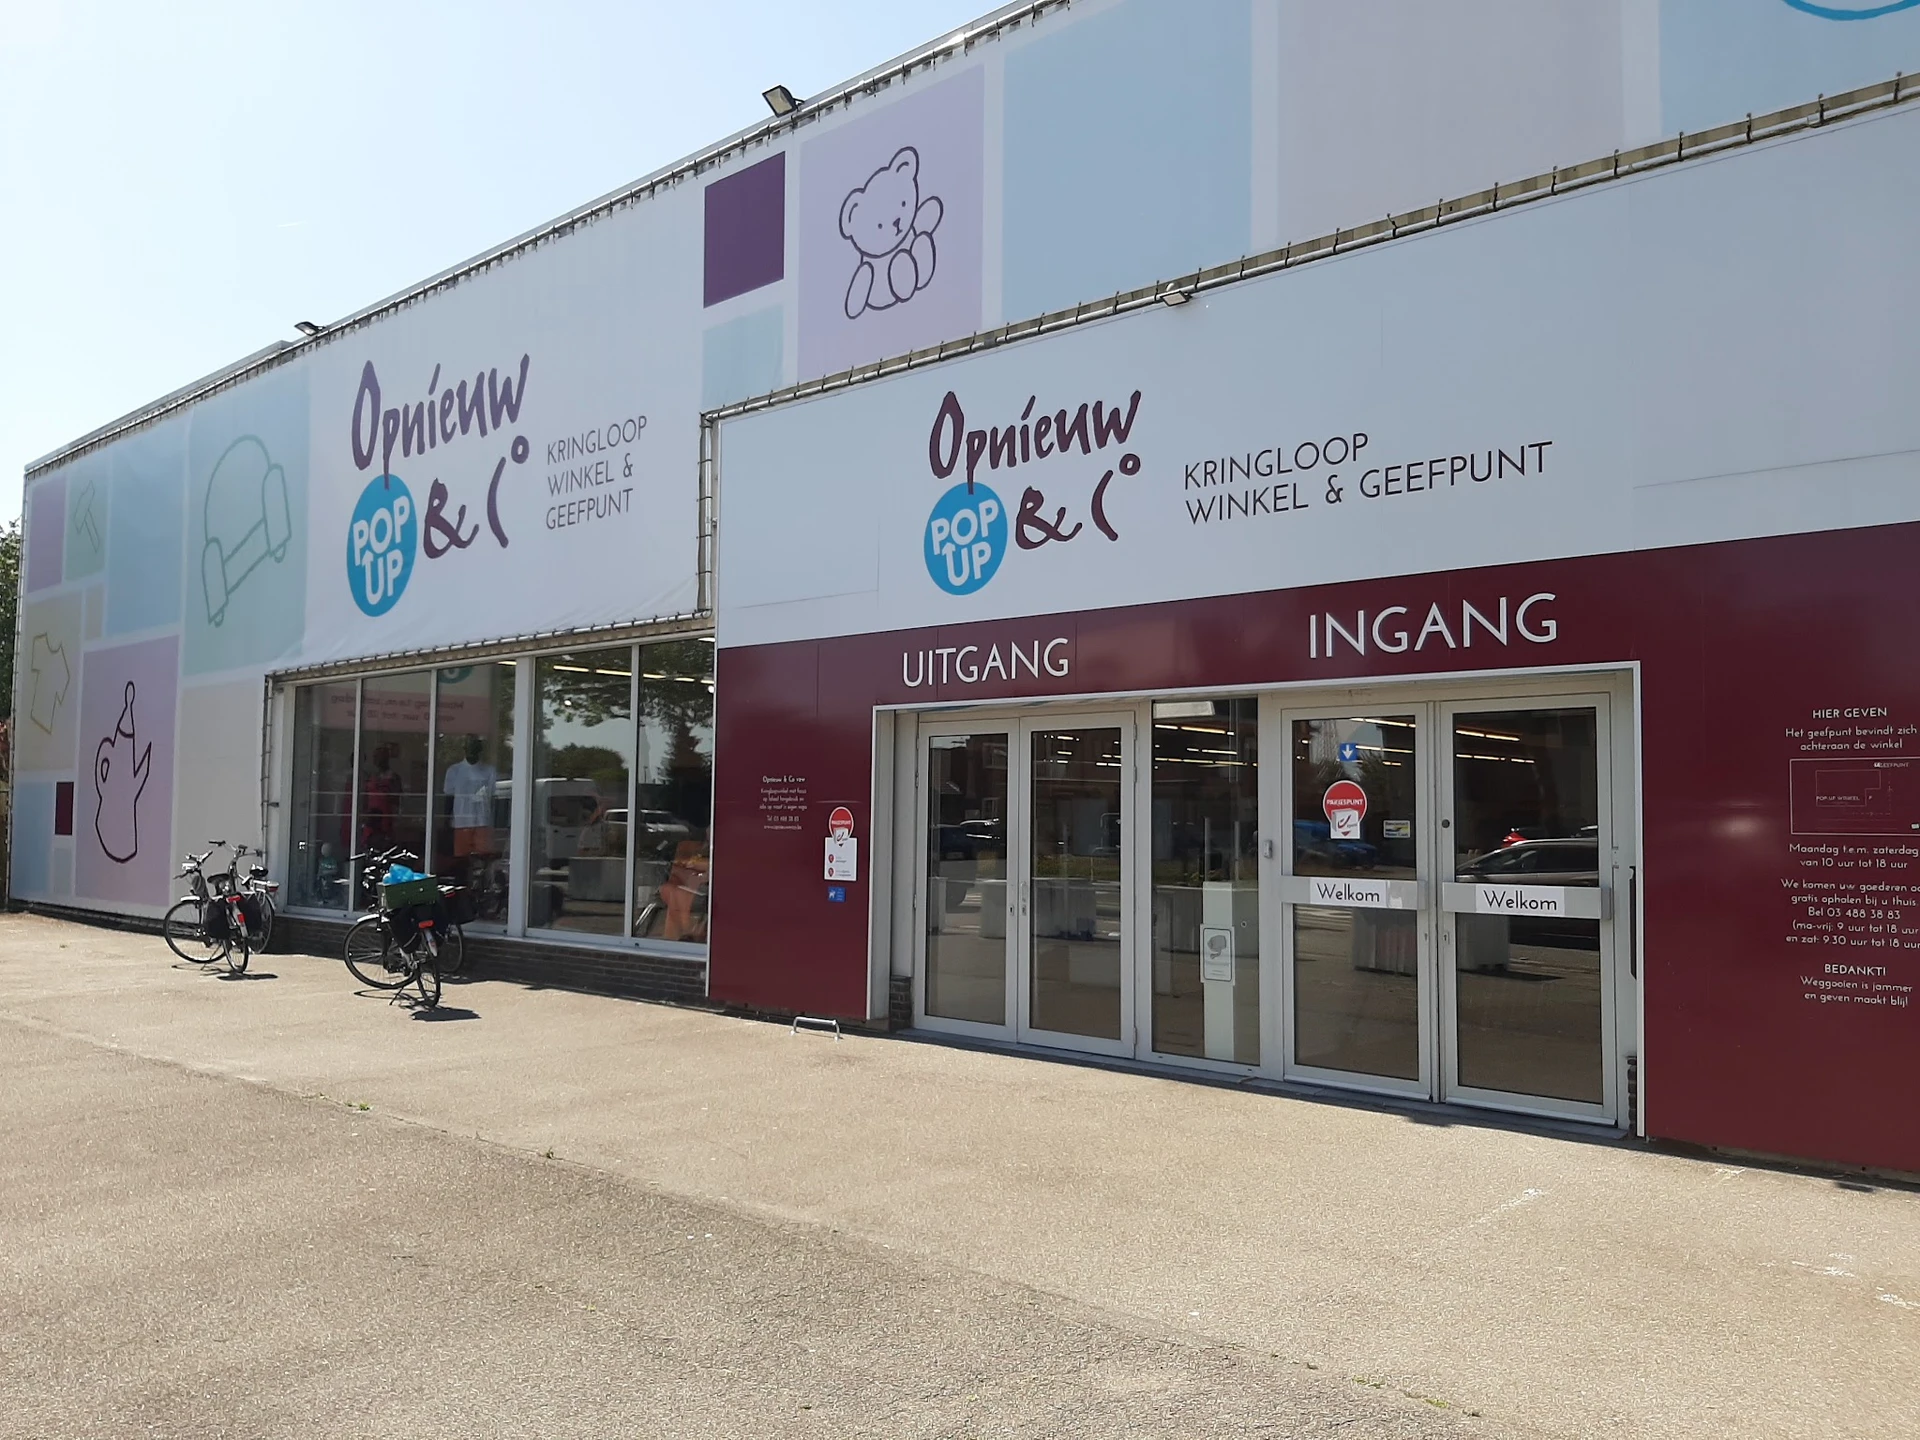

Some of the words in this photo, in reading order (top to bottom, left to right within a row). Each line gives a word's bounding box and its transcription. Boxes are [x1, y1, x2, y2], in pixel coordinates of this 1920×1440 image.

[352, 353, 530, 490] Opnieuw
[547, 415, 647, 466] KRINGLOOP
[929, 390, 1141, 495] Opnieuw
[547, 460, 615, 497] WINKEL
[623, 453, 633, 479] &
[1184, 432, 1369, 490] KRINGLOOP
[1185, 482, 1308, 525] WINKEL
[1326, 474, 1343, 504] &
[1359, 441, 1553, 499] GEEFPUNT
[423, 478, 479, 559] &
[546, 488, 633, 530] GEEFPUNT
[931, 497, 999, 555] POP
[1015, 486, 1082, 550] &
[353, 495, 410, 567] POP
[362, 549, 403, 605] UP
[942, 541, 991, 587] UP
[1309, 592, 1557, 659] INGANG
[903, 638, 1069, 687] UITGANG
[1785, 728, 1803, 738] Het
[1807, 726, 1852, 739] geefpunt
[1855, 725, 1893, 736] bevindt
[1897, 724, 1917, 735] zich
[1812, 708, 1840, 719] HIER
[1844, 707, 1887, 718] GEVEN
[1800, 741, 1850, 751] achteraan
[1853, 739, 1866, 749] de
[1870, 738, 1903, 749] winkel
[1789, 843, 1839, 856] Maandag
[1873, 844, 1919, 857] zaterdag
[1822, 858, 1834, 867] 10
[1858, 859, 1872, 868] tot
[1876, 858, 1887, 868] 18
[1316, 882, 1380, 903] Welkom
[1483, 889, 1557, 911] Welkom
[1780, 879, 1799, 889] We
[1802, 880, 1836, 890] komen
[1859, 881, 1907, 893] goederen
[1791, 894, 1818, 904] gratis
[1821, 893, 1861, 905] ophalen
[1865, 895, 1877, 906] bij
[1808, 907, 1823, 917] Bel
[1826, 907, 1841, 917] 03
[1845, 908, 1866, 918] 488
[1870, 909, 1884, 919] 38
[1887, 910, 1901, 920] 83
[1837, 922, 1844, 931] 9
[1869, 924, 1883, 933] tot
[1886, 924, 1898, 934] 18
[1901, 927, 1919, 935] uur
[1822, 935, 1847, 945] 9.30
[1871, 938, 1885, 946] tot
[1889, 938, 1900, 948] 18
[1800, 976, 1858, 989] Weggooien
[1861, 982, 1869, 990] is
[1872, 983, 1912, 993] jammer
[1820, 993, 1850, 1004] geven
[1853, 994, 1886, 1005] maakt
